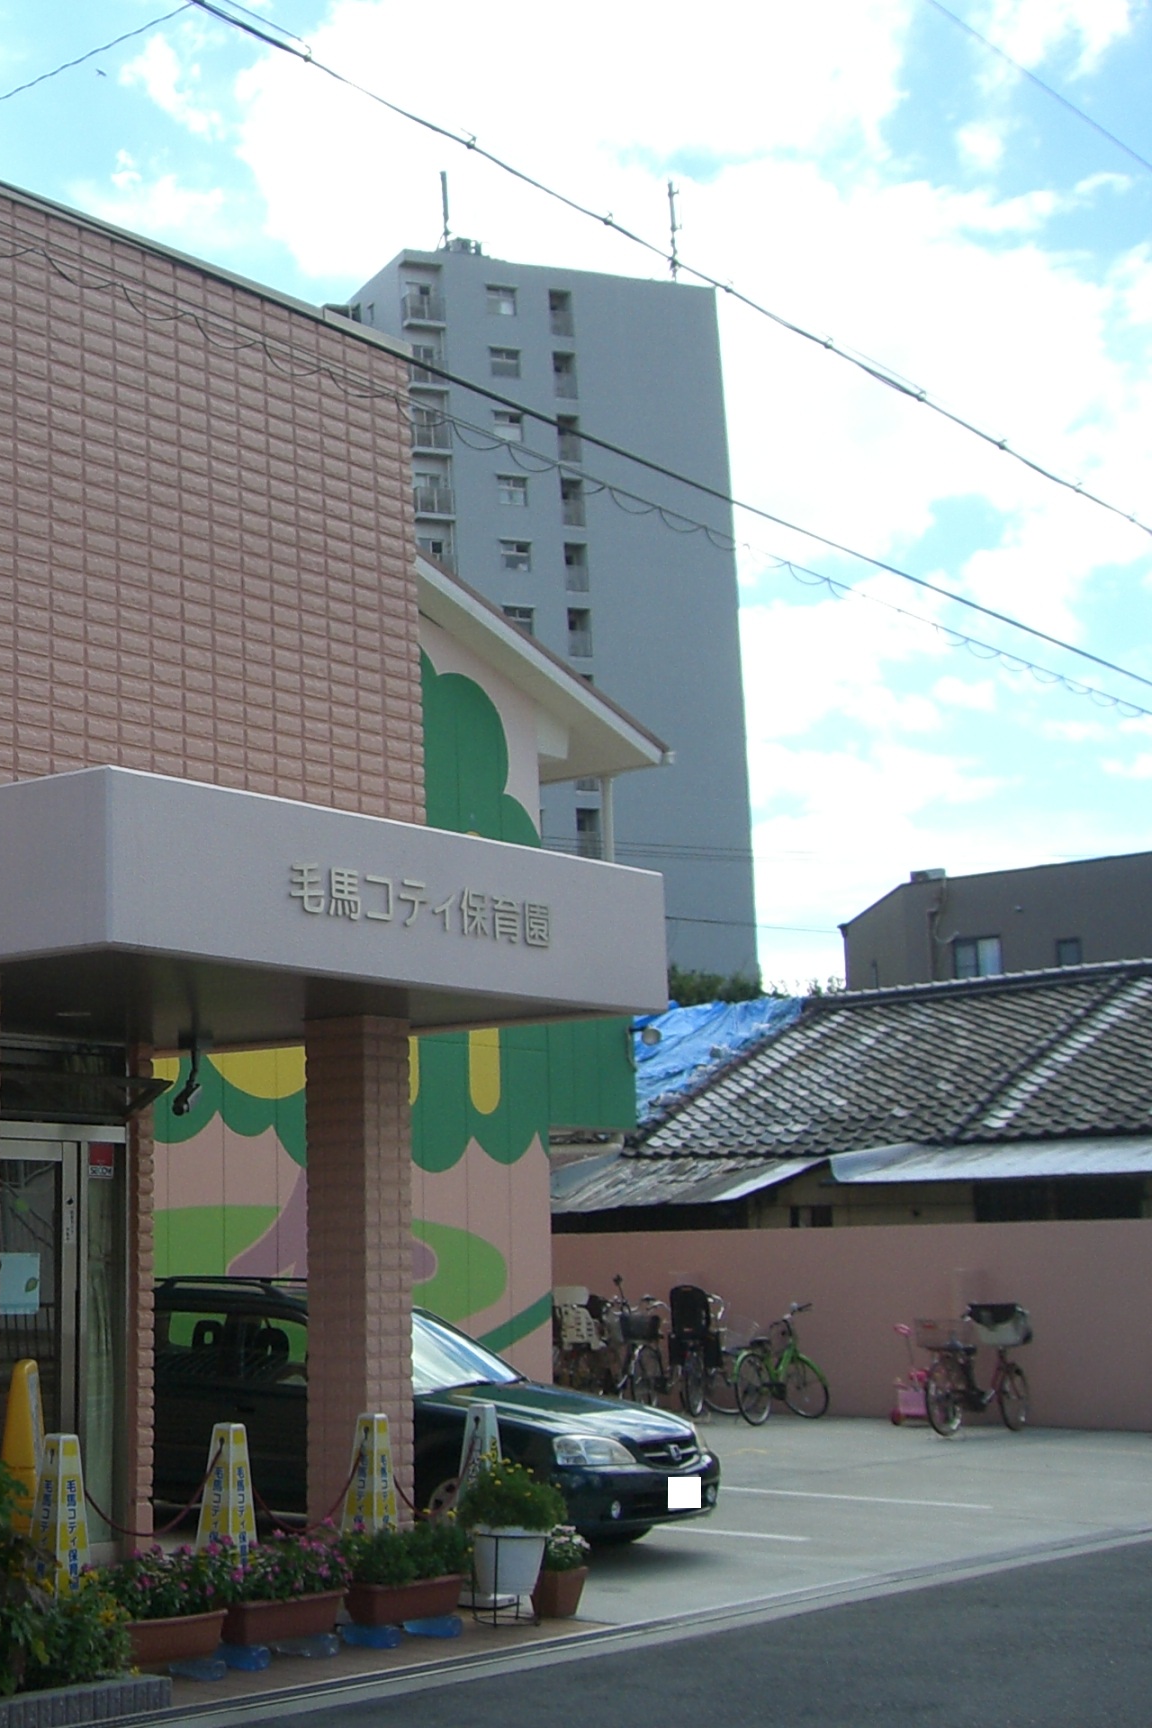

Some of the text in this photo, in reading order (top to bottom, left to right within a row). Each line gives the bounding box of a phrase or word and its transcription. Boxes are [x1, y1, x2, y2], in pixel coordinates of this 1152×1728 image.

[290, 862, 550, 948] 毛馬コティ保育園
